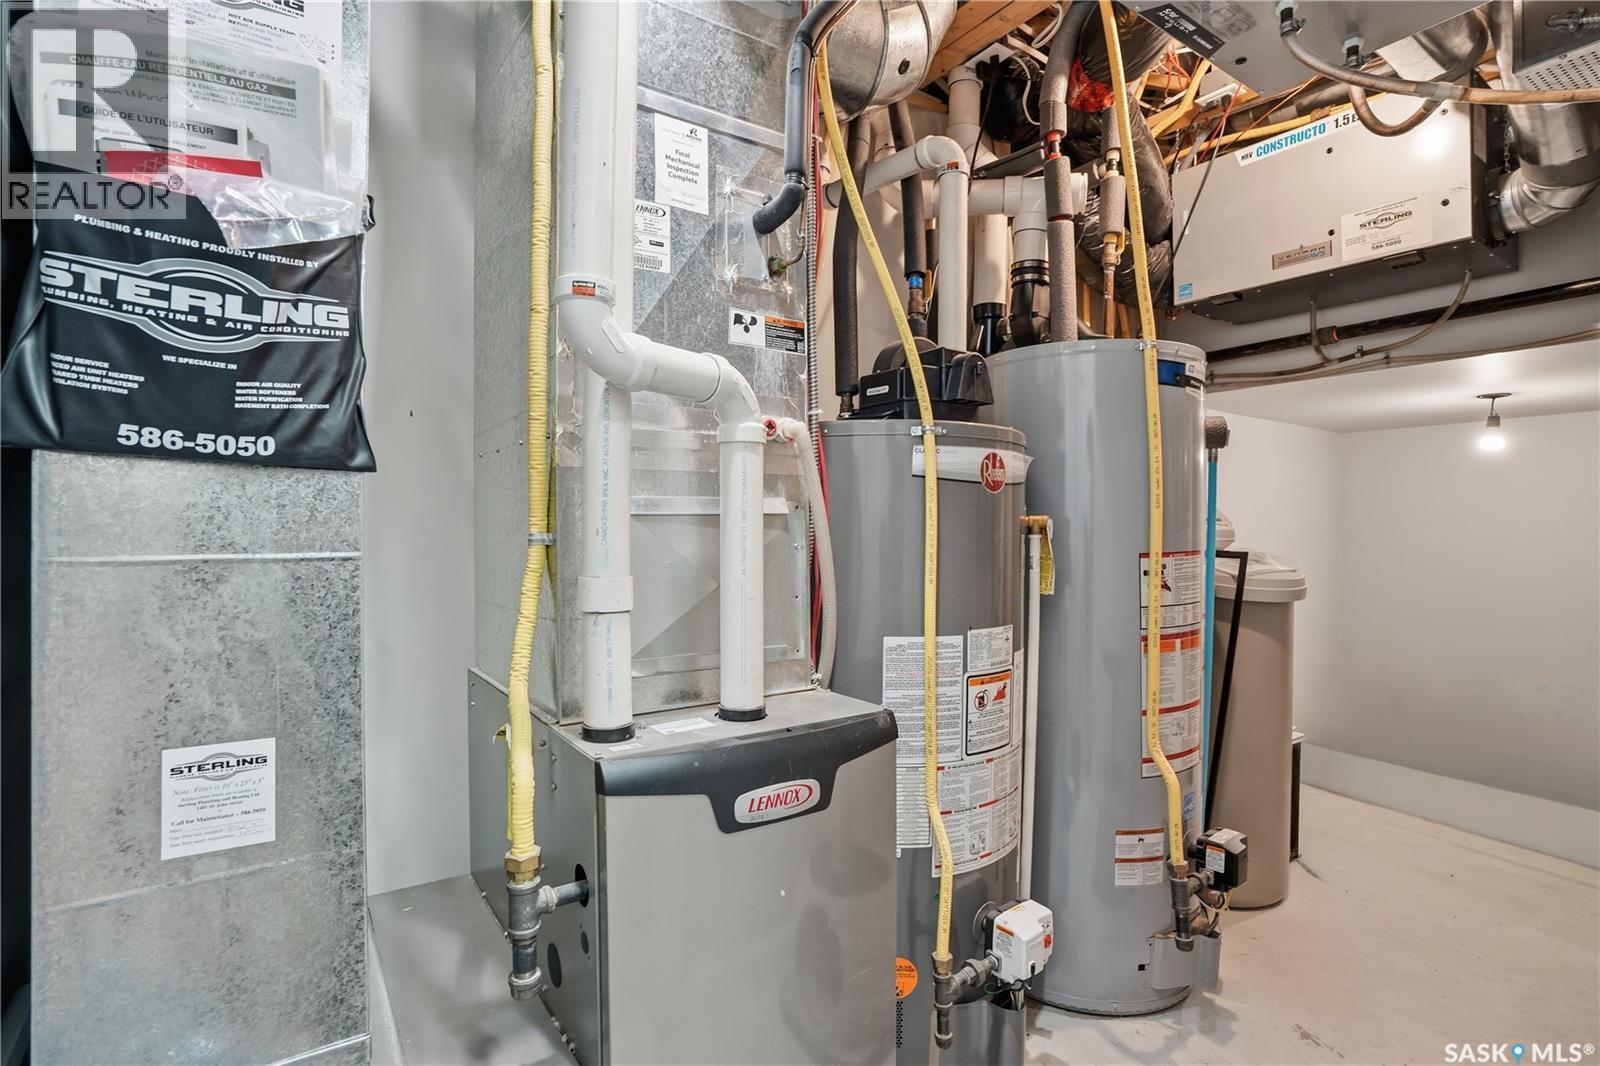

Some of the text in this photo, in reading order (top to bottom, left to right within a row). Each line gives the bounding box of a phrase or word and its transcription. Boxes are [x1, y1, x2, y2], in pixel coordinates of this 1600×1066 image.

[69, 54, 146, 70] CHAUFFE-EAU
[229, 77, 244, 89] AU
[246, 81, 269, 93] GAZ
[82, 105, 214, 136] GUIDE DE L'UTILISATEUR
[1255, 122, 1327, 157] CONSTRUCTO
[1333, 113, 1350, 129] 1.5
[664, 154, 701, 170] Mechanical
[675, 148, 691, 159] Final
[666, 163, 700, 177] Inspection
[667, 171, 699, 185] Complete
[635, 204, 659, 216] ENNOX
[1359, 210, 1413, 229] STERLING
[73, 213, 319, 269] PLUMBING & HEATING PROUDLY INSTALLED BY
[39, 257, 350, 328] STERLING
[122, 303, 199, 323] HEATING
[205, 318, 218, 326] &
[225, 321, 253, 331] AIR
[260, 325, 350, 337] CONDITIONING
[74, 357, 110, 369] SERVICE
[162, 354, 177, 363] WE
[177, 356, 226, 369] SPECIALIZE
[71, 365, 86, 373] AIR
[108, 371, 145, 382] HEATERS
[91, 383, 129, 395] SYSTEMS
[102, 377, 139, 389] HEATERS
[116, 423, 276, 457] 586-5050
[169, 756, 268, 776] STERLING
[748, 788, 801, 813] LENNOX
[171, 819, 184, 827] Call
